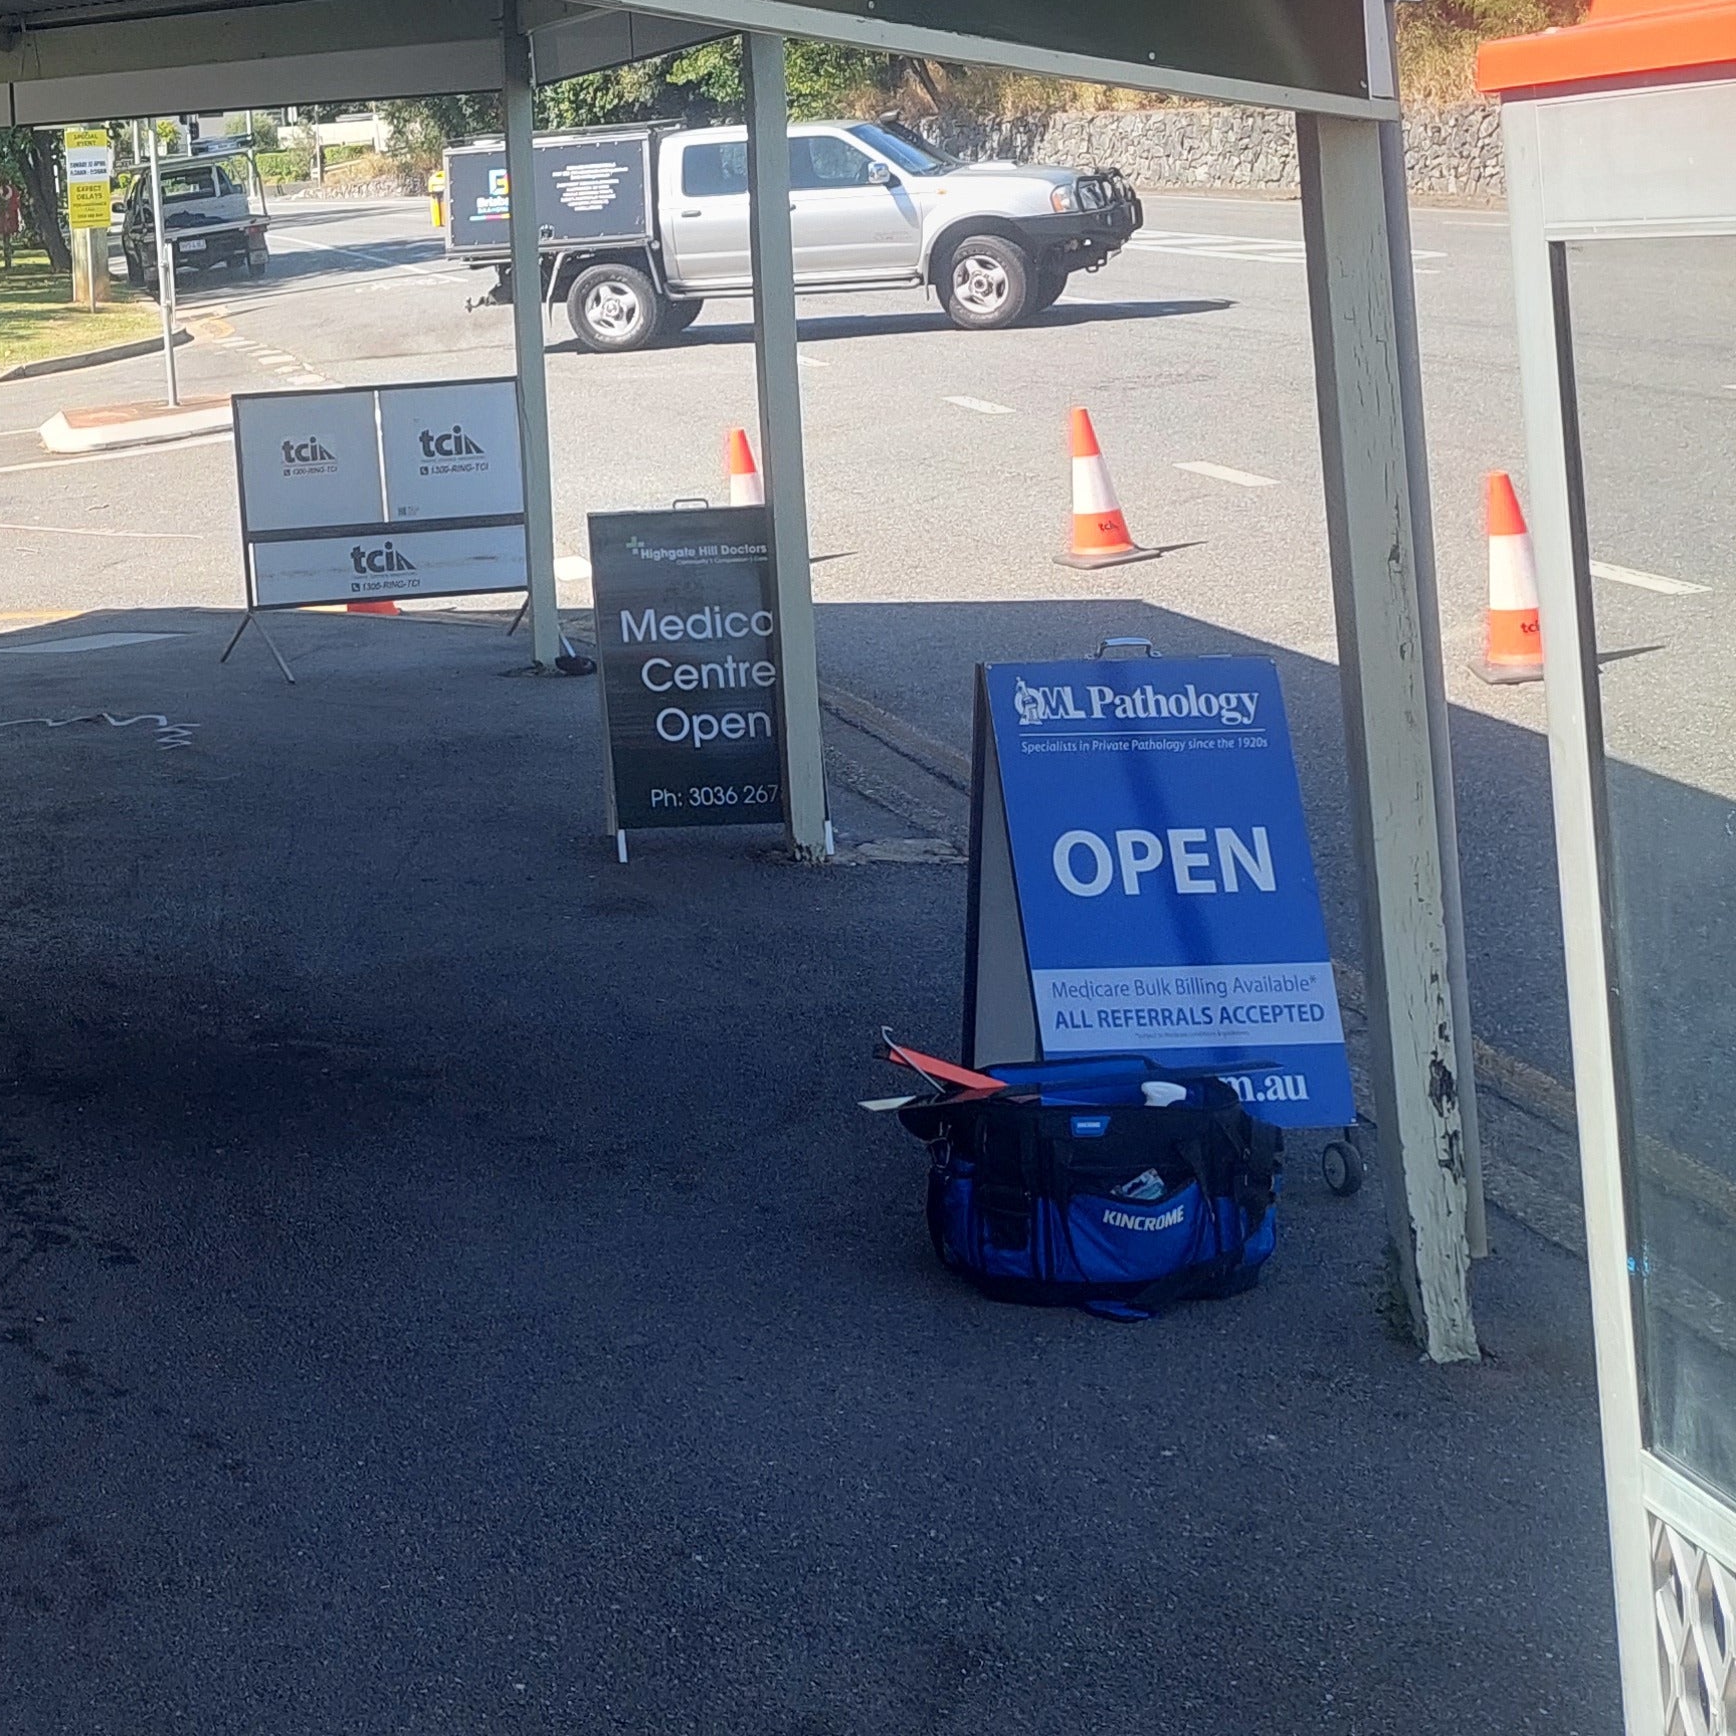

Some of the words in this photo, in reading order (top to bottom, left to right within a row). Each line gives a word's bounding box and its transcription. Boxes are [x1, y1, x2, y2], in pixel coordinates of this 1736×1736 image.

[76, 192, 103, 201] DELAYS
[641, 547, 696, 562] Highgate
[698, 544, 719, 557] Hill
[720, 543, 768, 555] Doctors
[641, 654, 777, 693] Centre
[1085, 684, 1261, 726] Pathology
[656, 707, 772, 749] Open
[1021, 741, 1077, 754] Specialists
[1079, 739, 1090, 751] in
[1091, 739, 1130, 752] Private
[1131, 738, 1186, 753] Pathology
[1188, 737, 1215, 750] since
[1217, 737, 1235, 749] the
[1237, 736, 1268, 749] 1920s
[650, 788, 684, 808] Ph:
[688, 785, 739, 806] 3036
[1052, 826, 1278, 898] OPEN
[1051, 979, 1130, 1001] Medicare
[1135, 977, 1172, 996] Bulk
[1175, 976, 1228, 998] Billing
[1054, 1010, 1094, 1031] ALL
[1098, 1006, 1214, 1028] REFERRALS
[1218, 1002, 1326, 1025] ACCEPTED
[1102, 1204, 1185, 1232] KINCROME
